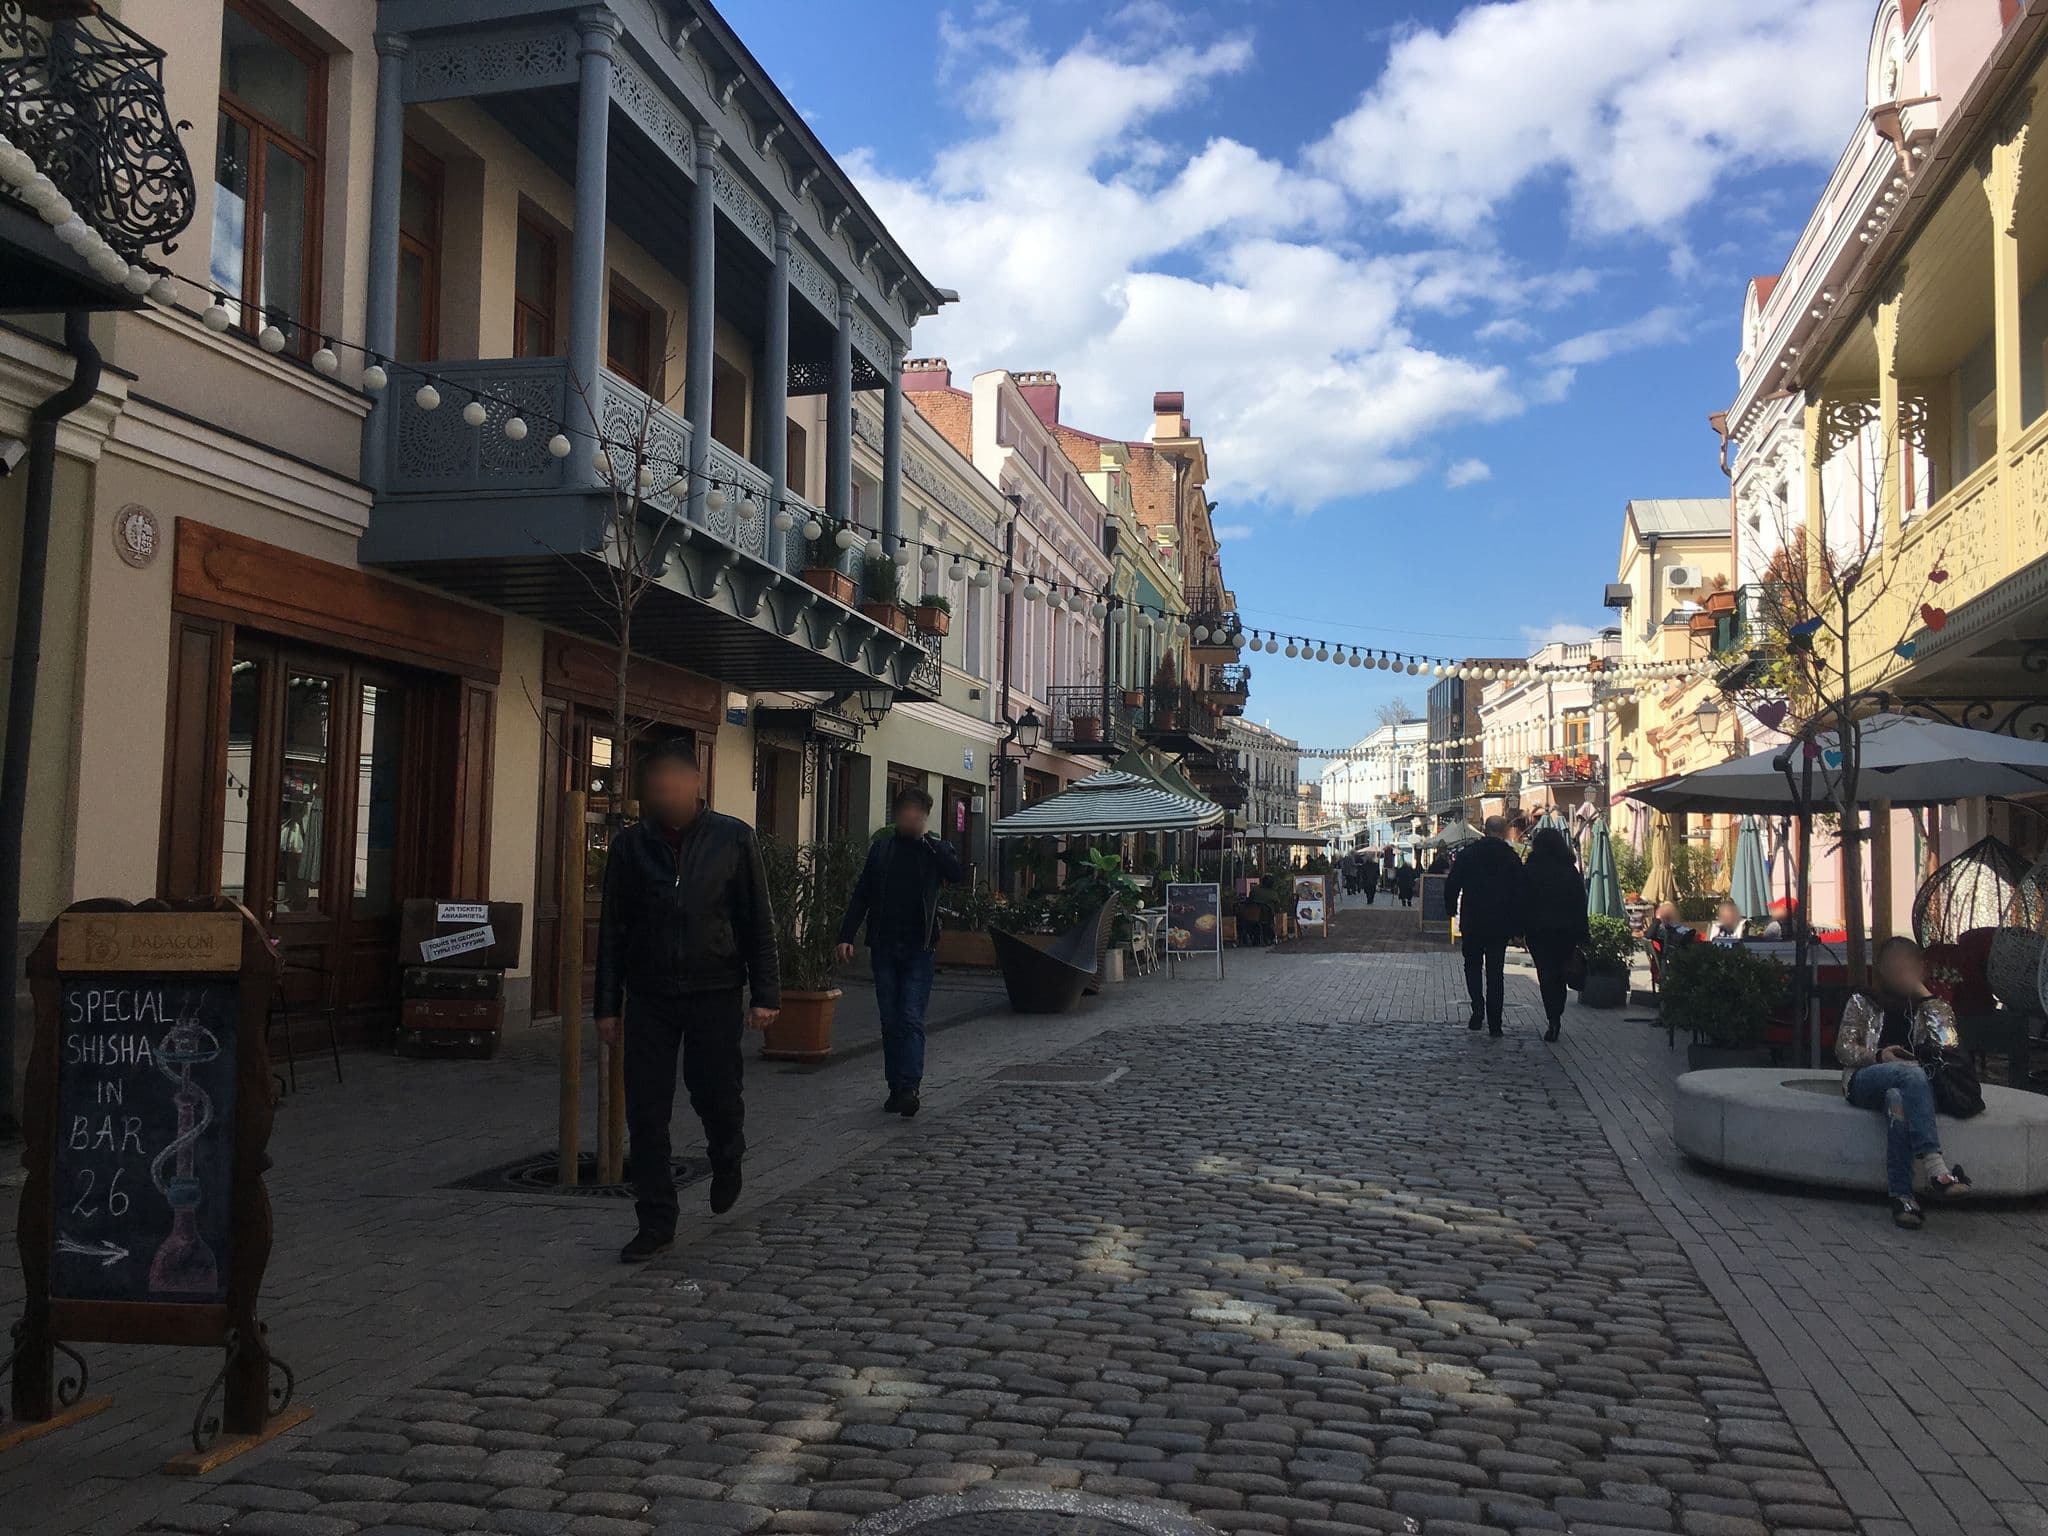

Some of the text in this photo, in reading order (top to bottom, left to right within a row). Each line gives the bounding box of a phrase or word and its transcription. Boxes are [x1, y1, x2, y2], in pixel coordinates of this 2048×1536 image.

[429, 939, 450, 950] TOURS
[457, 931, 486, 941] GEORGIA
[69, 990, 174, 1024] SPECIAL
[67, 1033, 154, 1067] SHISHA
[97, 1078, 124, 1105] IN
[68, 1114, 147, 1156] BAR
[71, 1167, 131, 1219] 26
